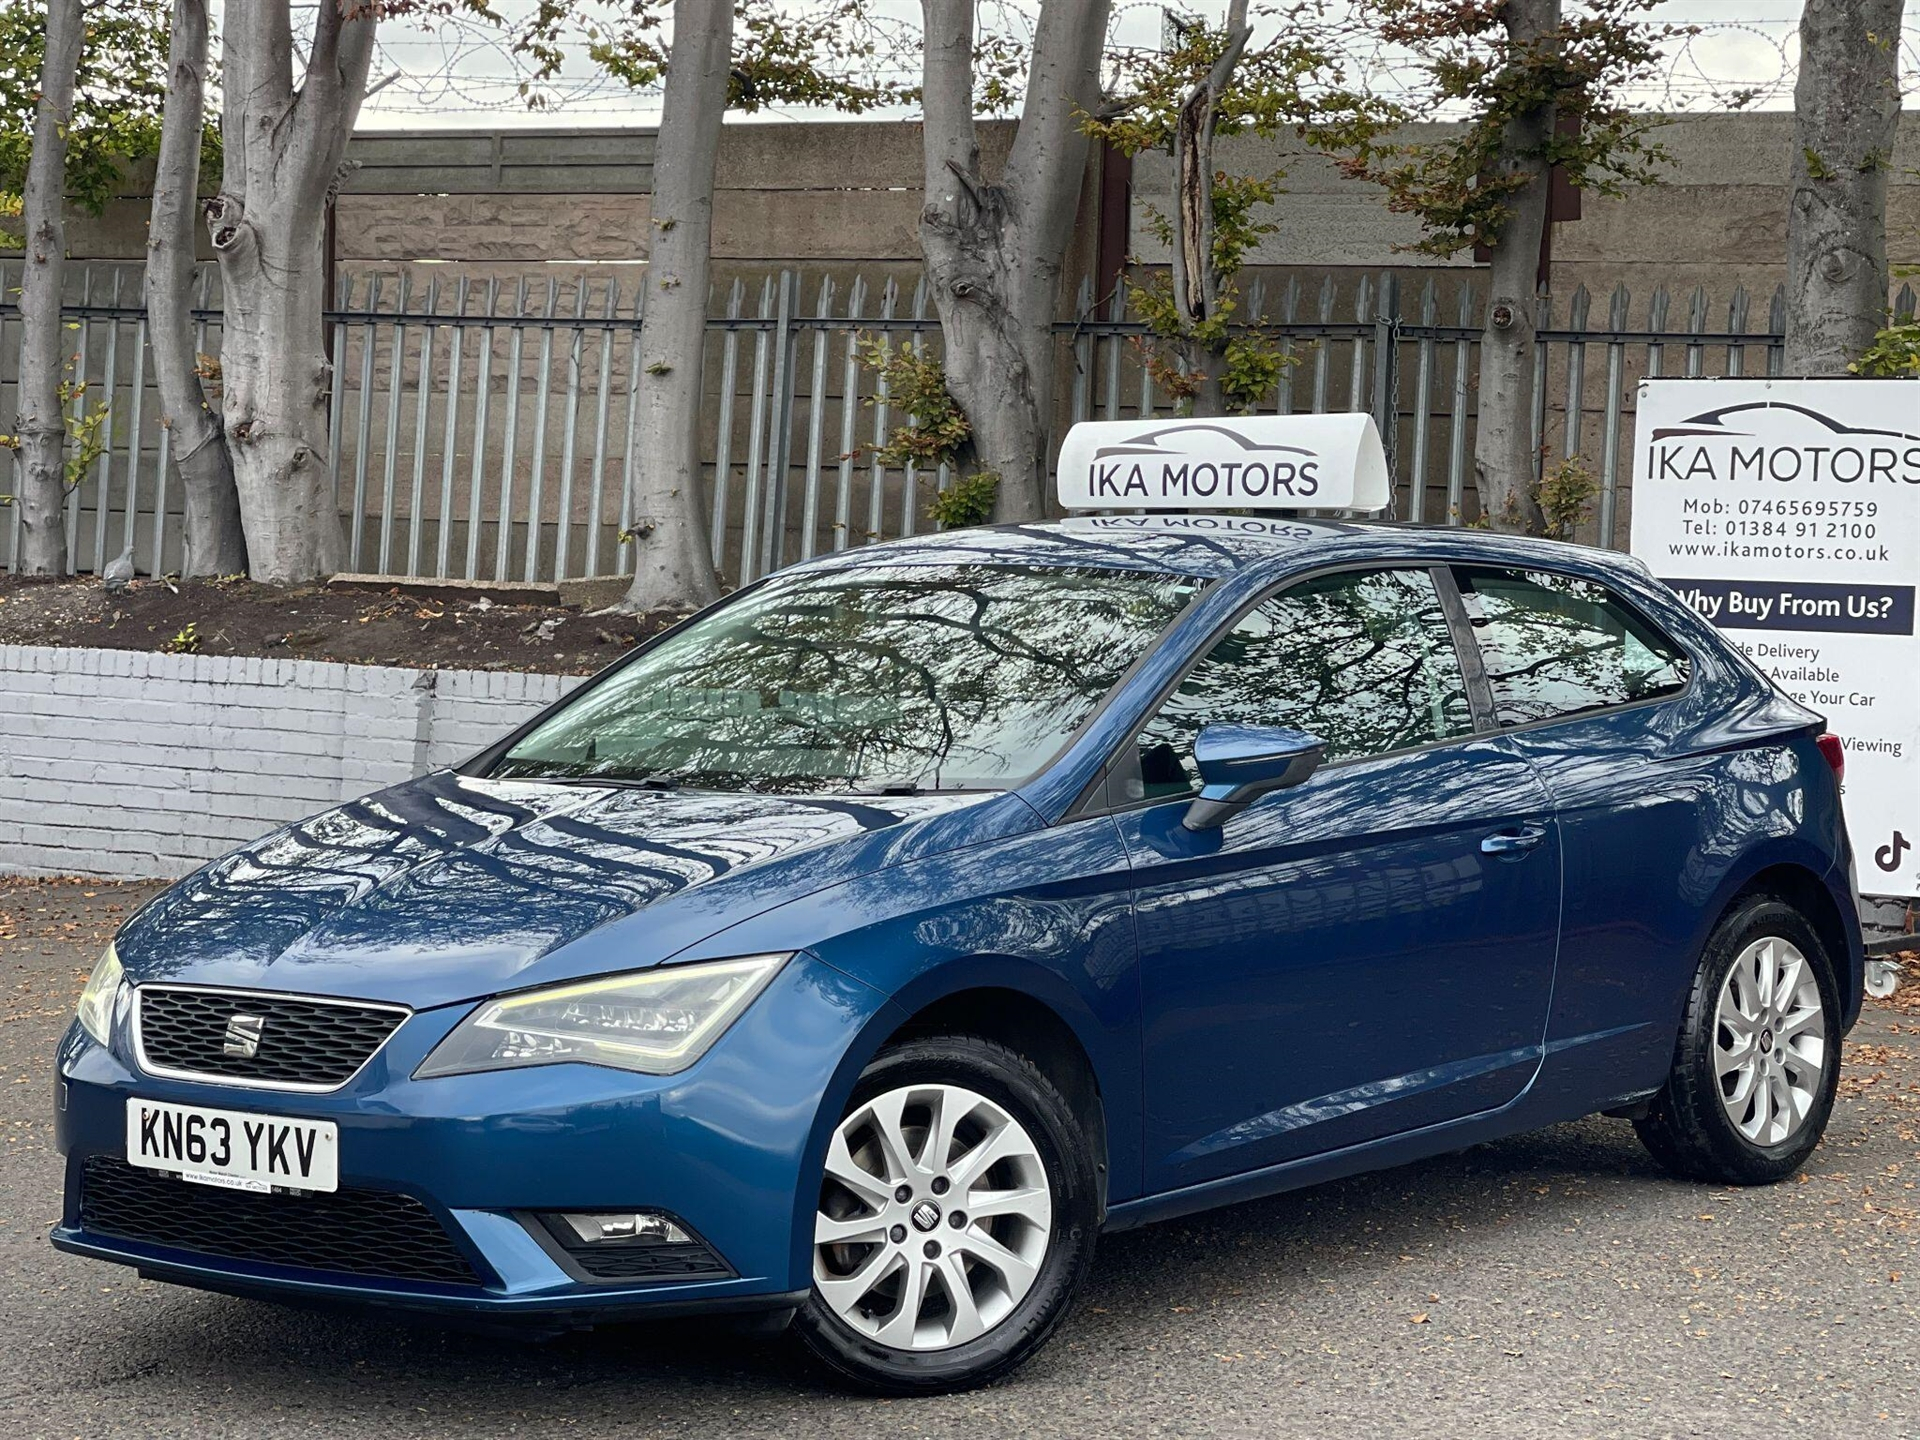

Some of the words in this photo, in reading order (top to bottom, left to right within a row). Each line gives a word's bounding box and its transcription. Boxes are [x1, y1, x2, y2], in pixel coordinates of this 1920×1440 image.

[1648, 445, 1717, 481] IKA
[1729, 446, 1920, 484] MOTORS
[1088, 463, 1149, 497] IKA
[1161, 462, 1319, 497] MOTORS
[1683, 499, 1730, 514] Mob:
[1738, 500, 1878, 517] 07465695759
[1683, 520, 1717, 535] Tel:
[1725, 521, 1787, 537] 01384
[1795, 522, 1817, 538] 91
[1826, 523, 1876, 538] 2100
[1668, 541, 1889, 561] www.ikamotors.co.uk
[1729, 591, 1774, 621] Buy
[1779, 593, 1840, 617] From
[1847, 595, 1893, 619] Us?
[1757, 643, 1820, 662] Delivery
[1770, 666, 1840, 683] Available
[1810, 690, 1845, 705] Your
[1849, 692, 1876, 706] Car
[1840, 736, 1902, 757] Viewing
[141, 1107, 231, 1167] KN63
[243, 1120, 317, 1178] YKV
